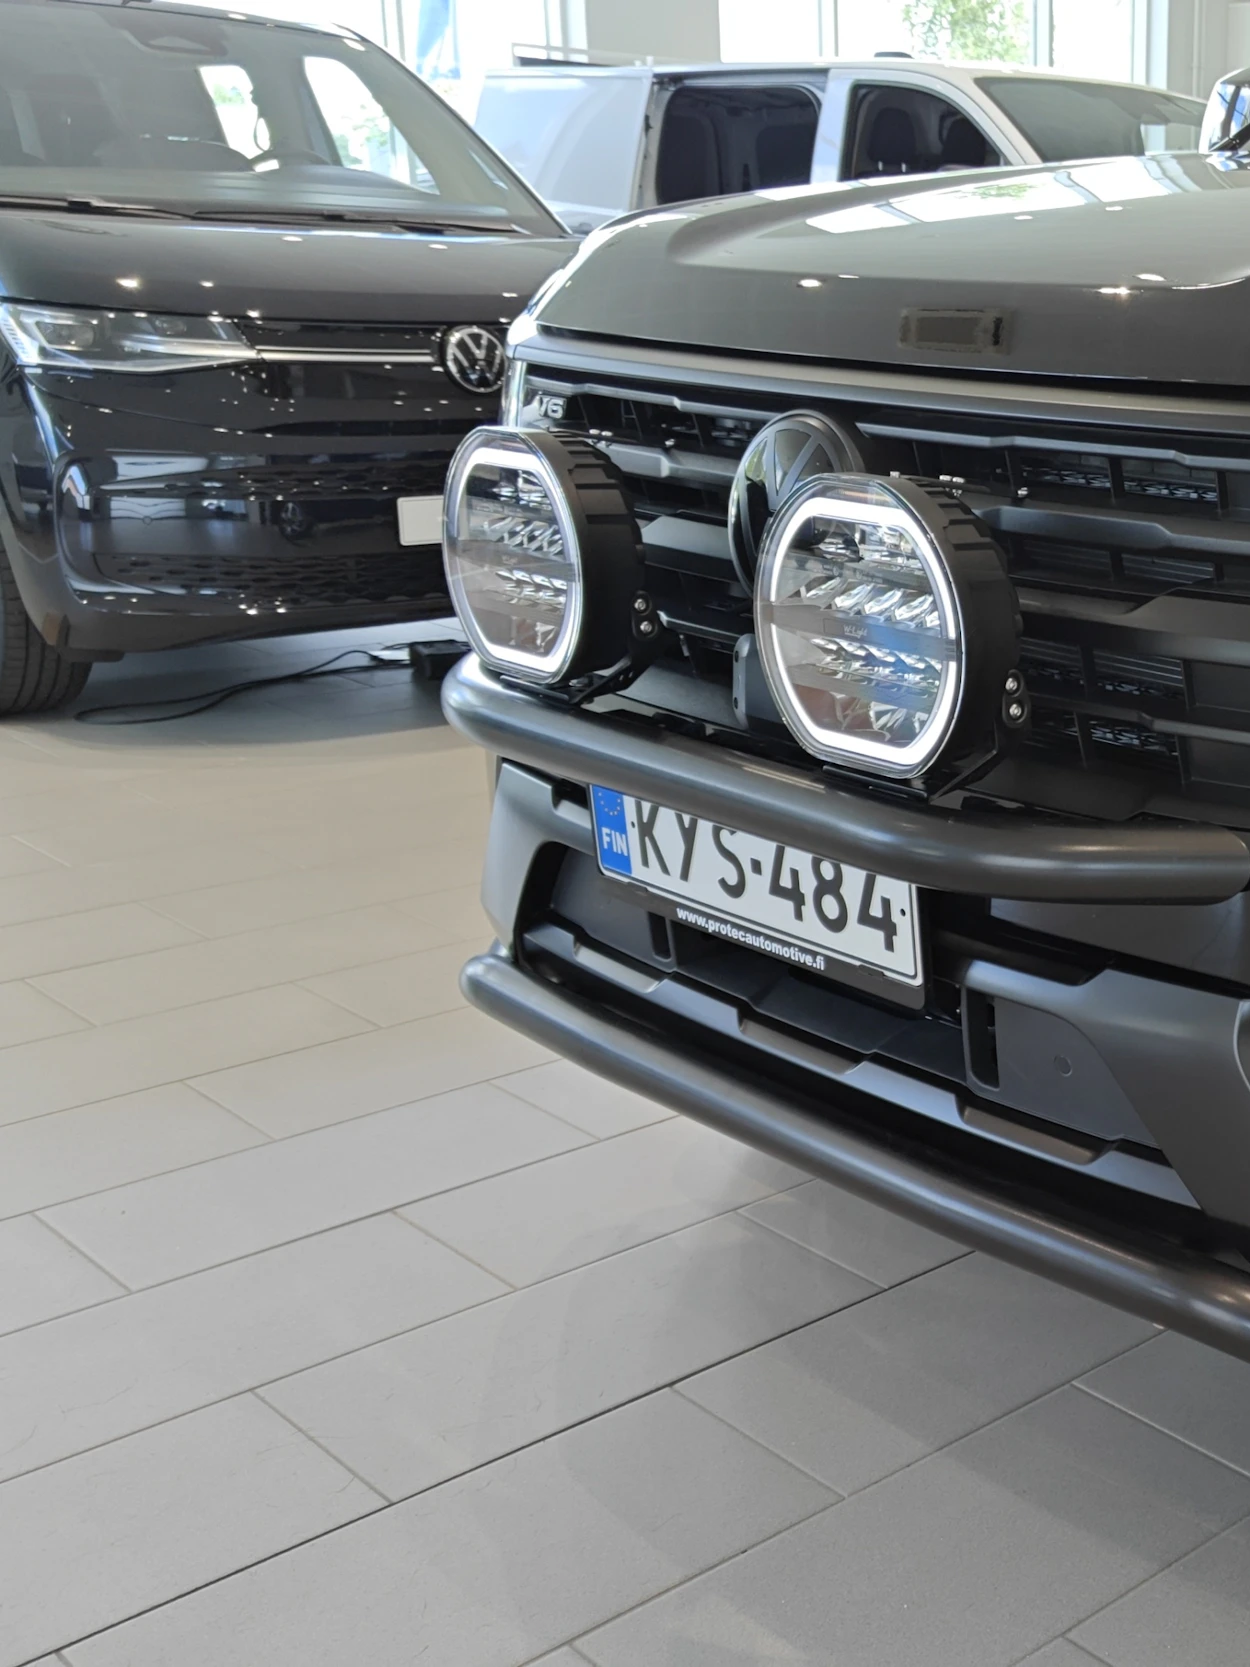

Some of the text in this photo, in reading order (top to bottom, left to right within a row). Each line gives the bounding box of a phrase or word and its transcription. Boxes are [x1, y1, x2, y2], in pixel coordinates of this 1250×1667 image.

[601, 827, 629, 857] FIN
[634, 799, 898, 953] KYS-484
[676, 907, 826, 971] www.protecautomotive.fi
